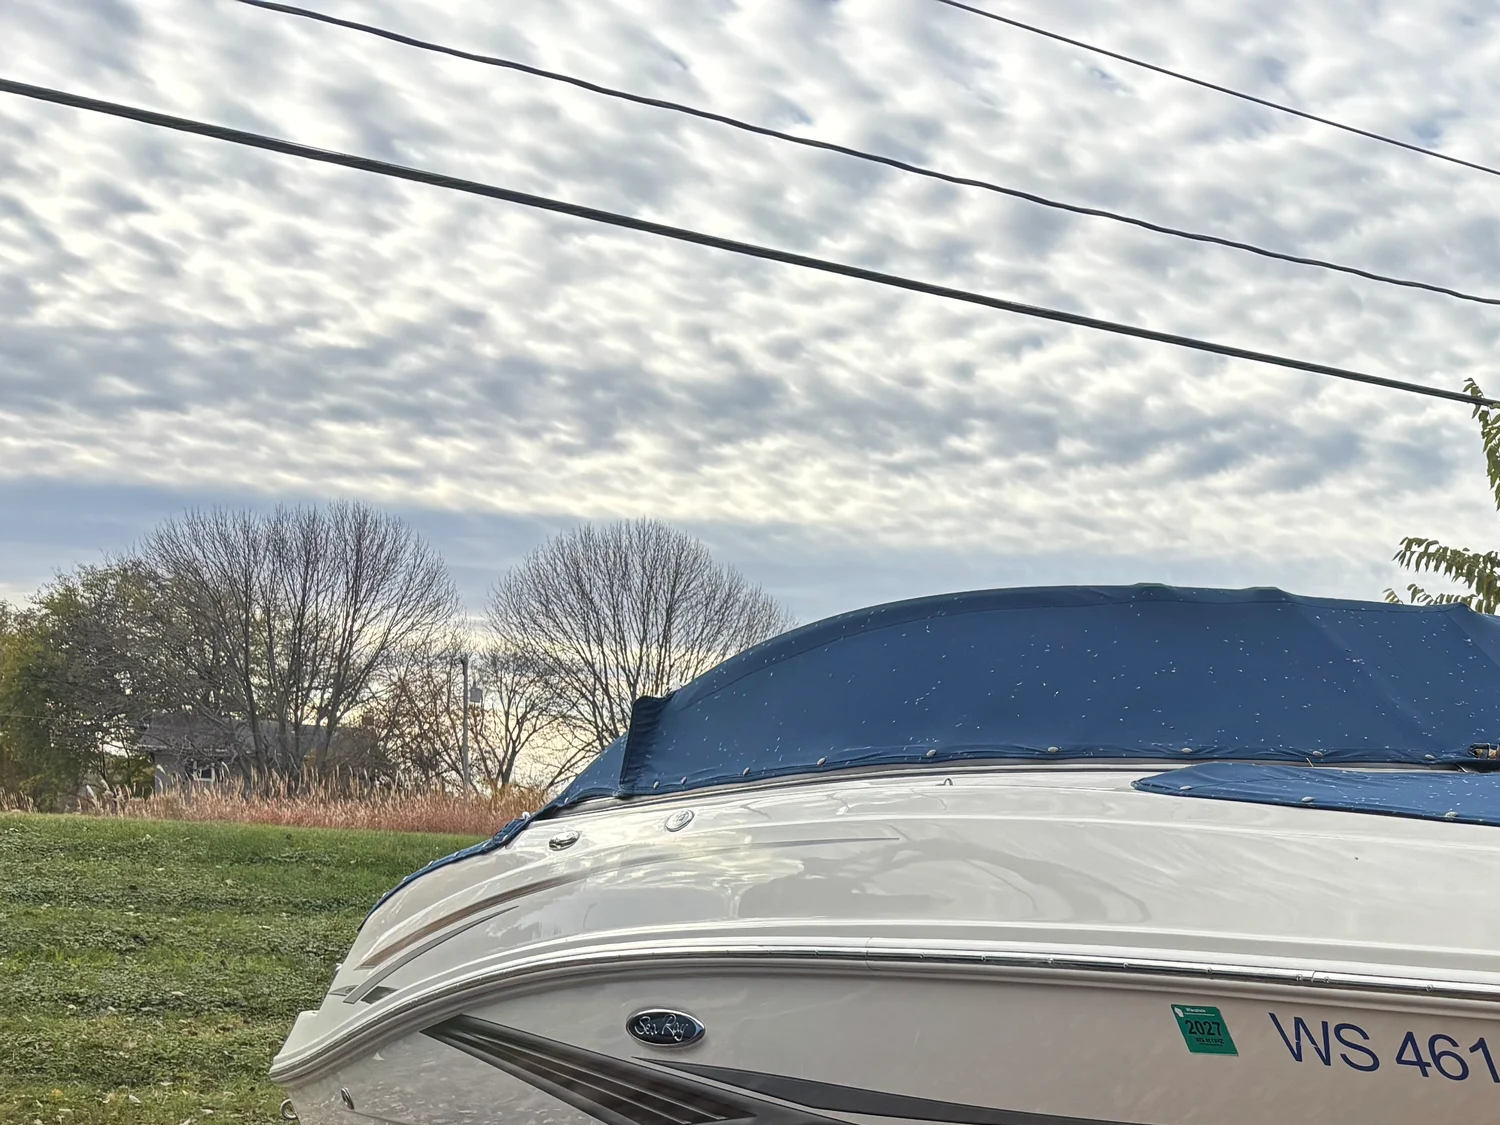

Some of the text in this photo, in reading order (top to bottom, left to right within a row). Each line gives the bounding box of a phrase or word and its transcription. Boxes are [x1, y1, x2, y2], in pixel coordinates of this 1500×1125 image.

[634, 1014, 689, 1041] Sea Ray
[1185, 1019, 1221, 1036] 2027
[1268, 1012, 1380, 1072] WS
